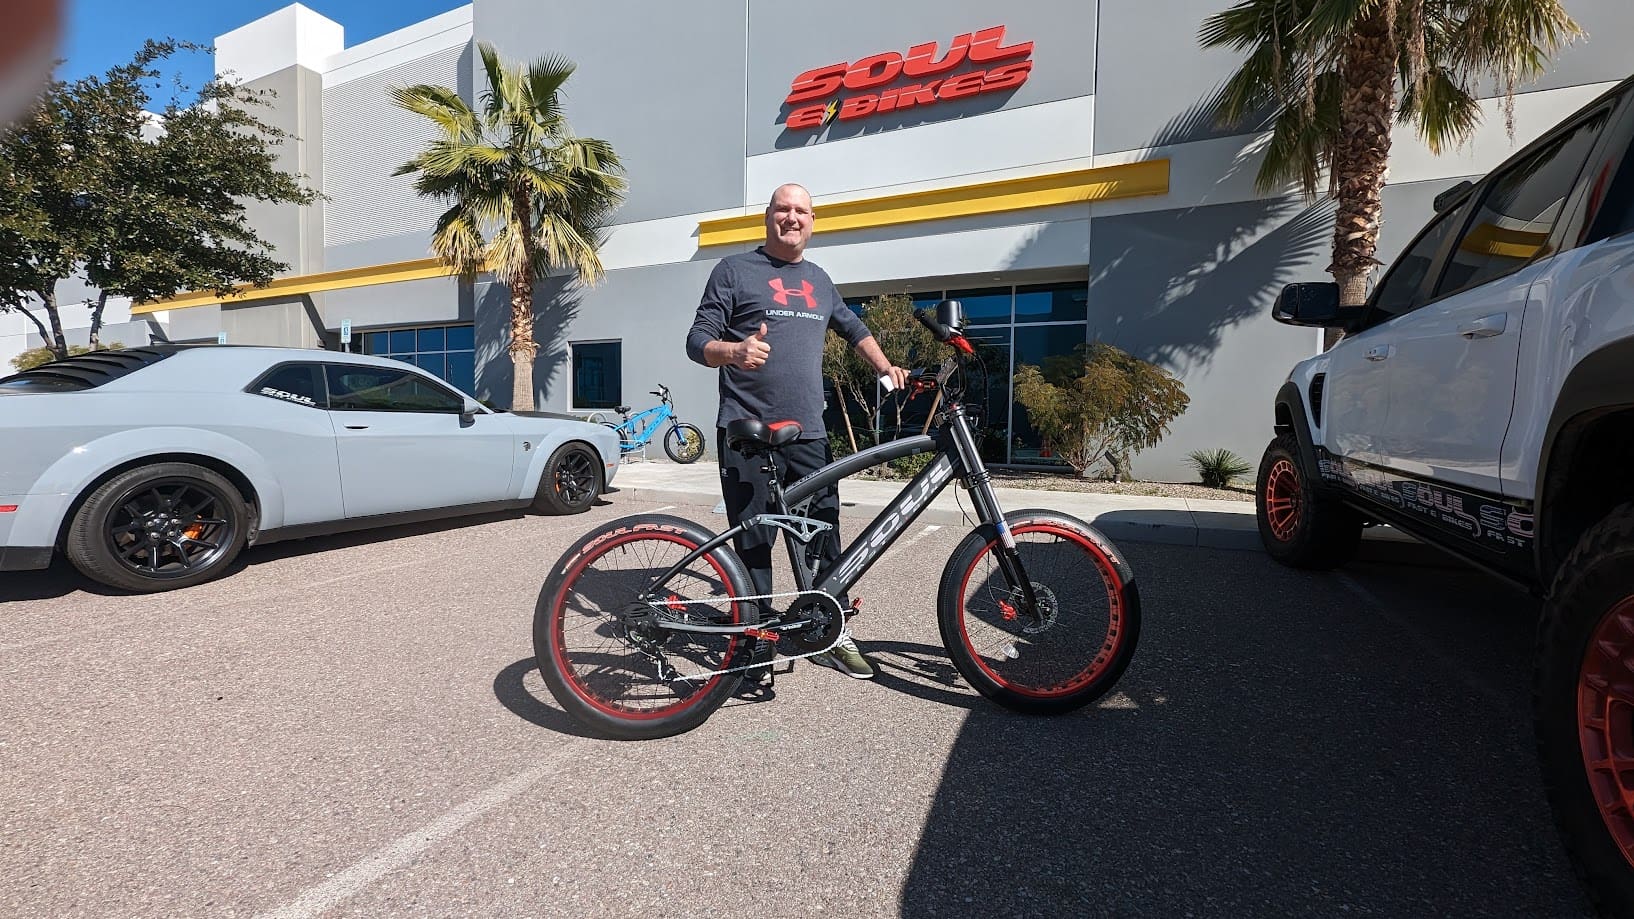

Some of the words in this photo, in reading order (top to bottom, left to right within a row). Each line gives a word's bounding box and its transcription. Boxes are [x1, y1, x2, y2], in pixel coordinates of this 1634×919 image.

[785, 24, 1034, 104] SOUL
[837, 59, 1033, 121] BIKES
[765, 309, 795, 317] UNDER
[838, 463, 953, 584] SOUL
[1402, 481, 1481, 538] SOUL
[582, 526, 633, 555] SOUL
[632, 523, 689, 535] FAST
[1487, 529, 1526, 548] FAST
